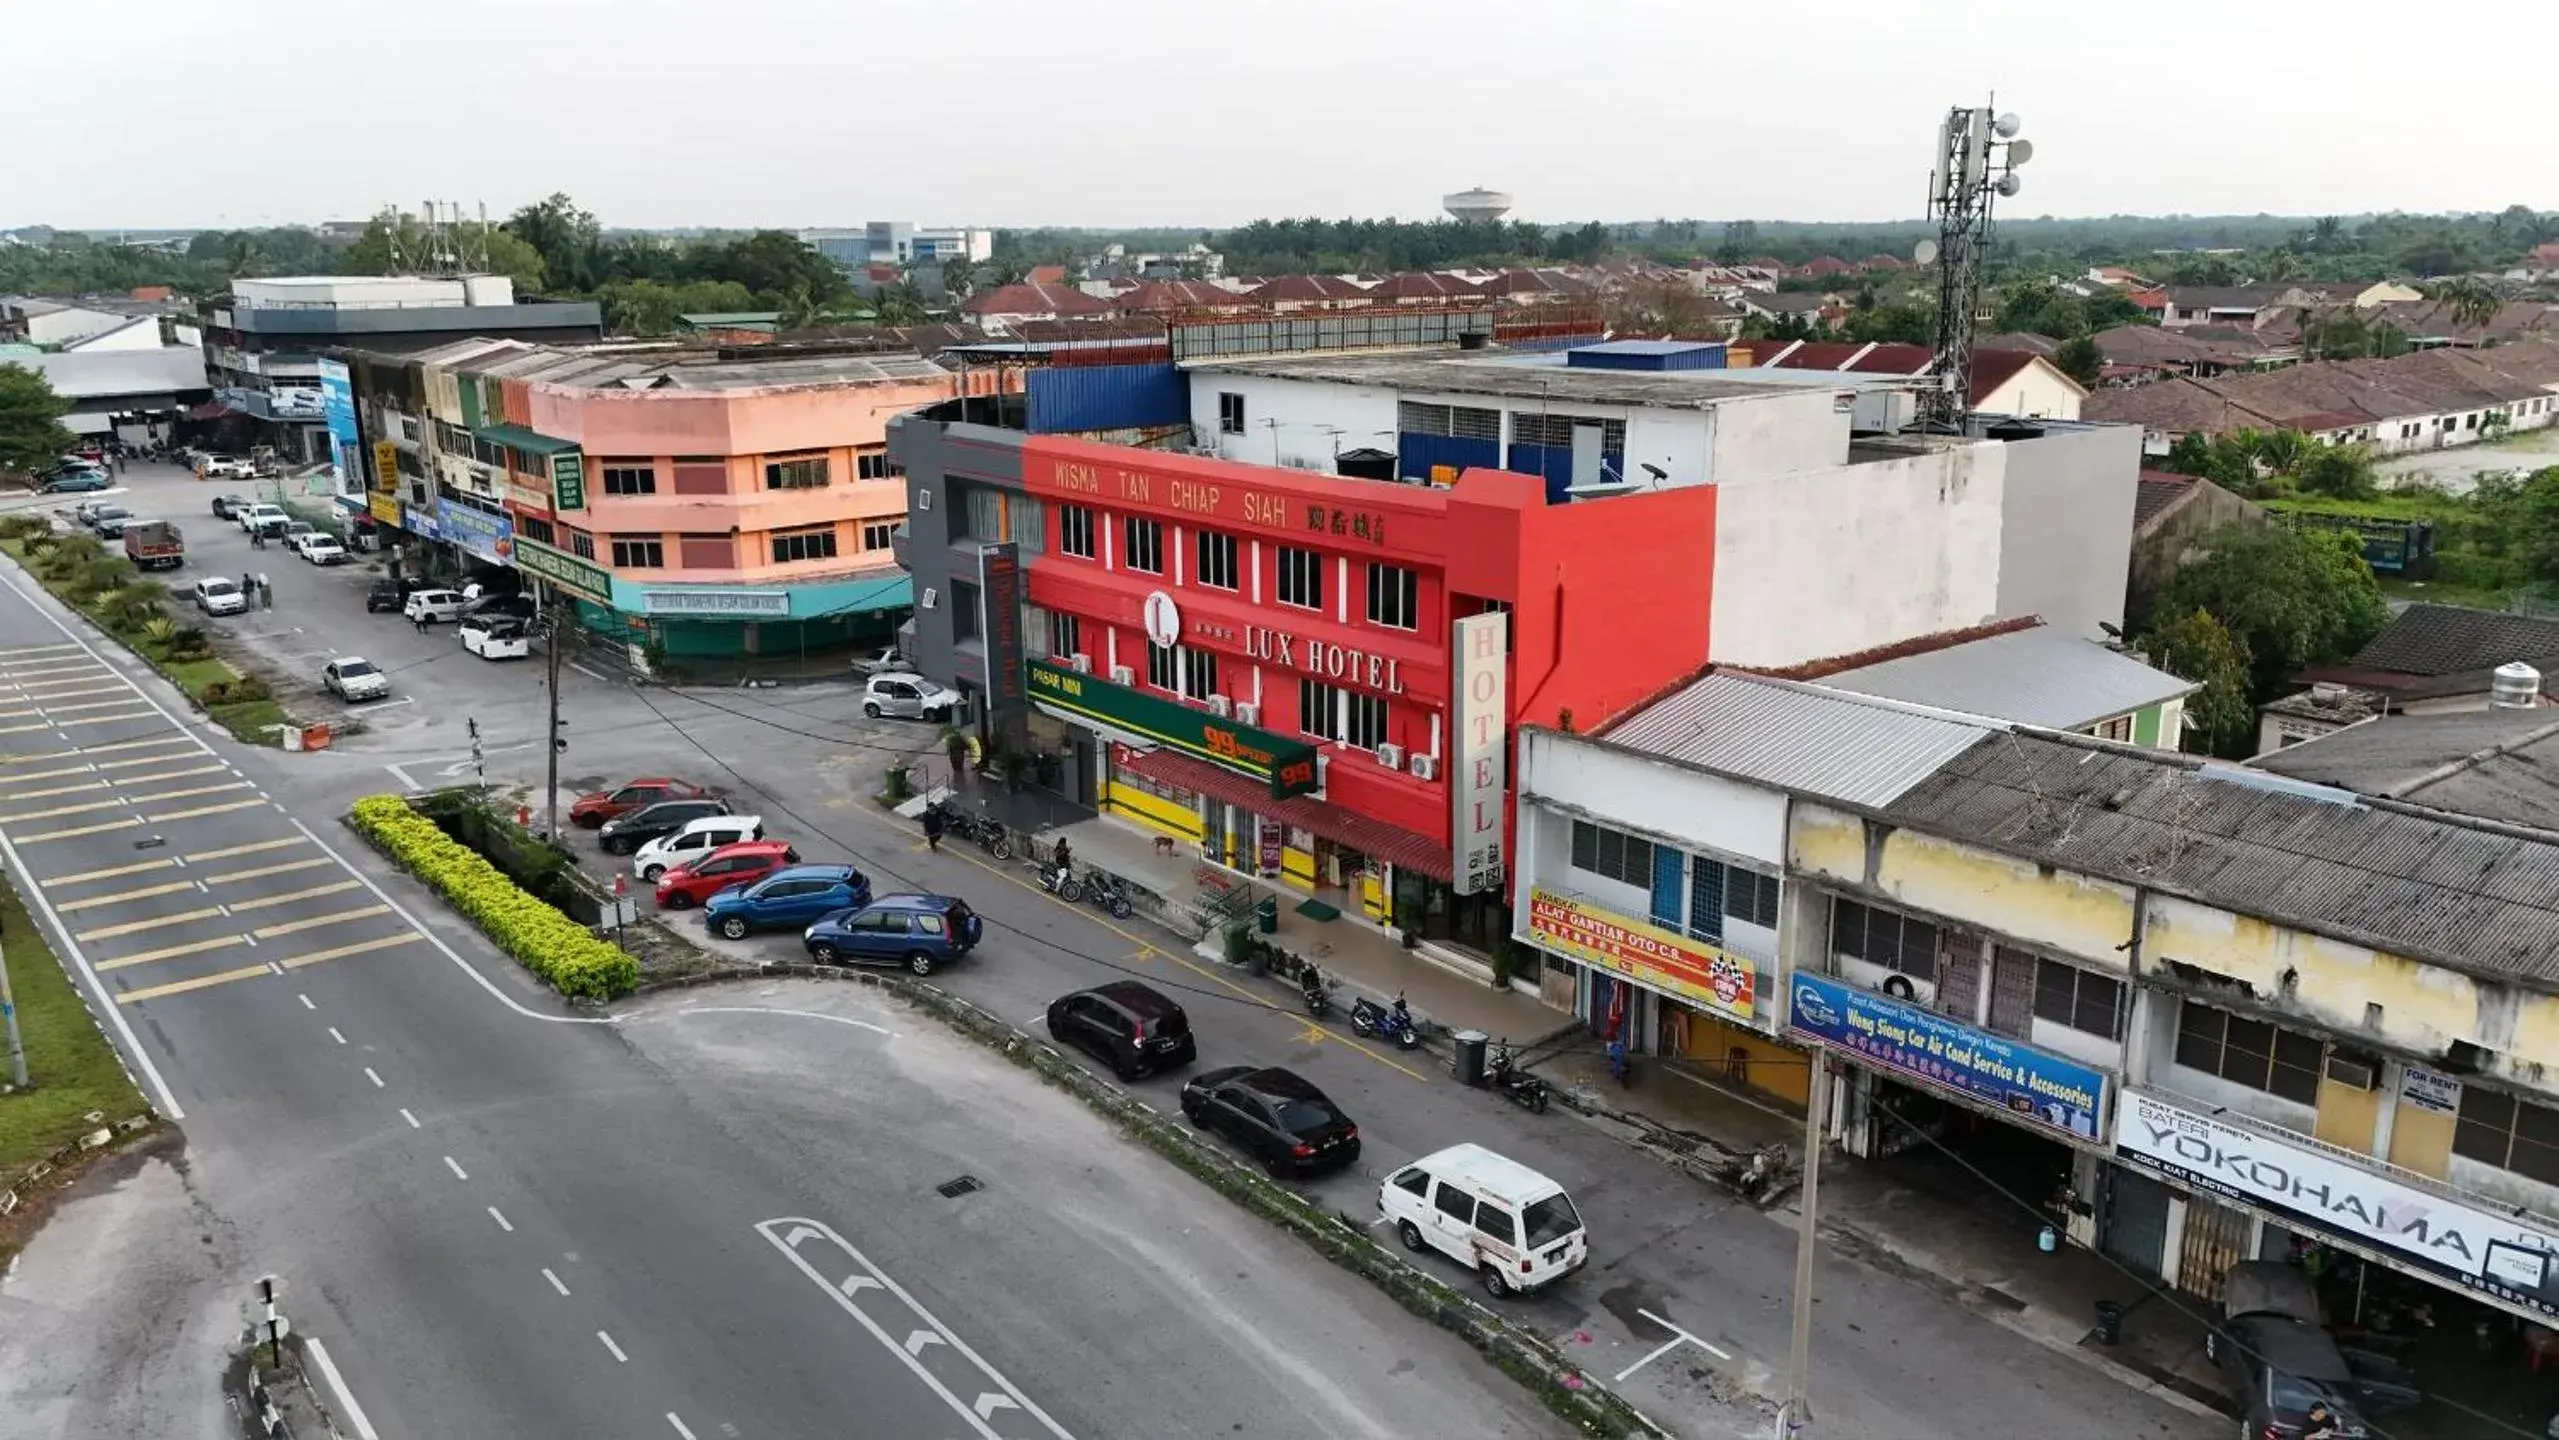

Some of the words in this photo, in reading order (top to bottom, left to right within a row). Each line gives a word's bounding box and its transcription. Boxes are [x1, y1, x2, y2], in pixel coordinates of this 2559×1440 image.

[1119, 471, 1150, 502] TAN
[1171, 480, 1220, 513] CHIAP
[1244, 492, 1288, 528] SIAH
[1244, 625, 1293, 667] LUX
[1307, 639, 1403, 694] HOTEL
[1204, 725, 1237, 757] 99
[1472, 626, 1498, 834] HOTEL
[1281, 761, 1313, 788] 99
[1536, 903, 1566, 920] ALAT
[1569, 913, 1626, 942] GANTIAN
[1628, 934, 1656, 953] OTO
[1908, 1028, 1926, 1049] Car
[1927, 1034, 1944, 1057] Air
[1945, 1041, 1971, 1067] Cond
[1973, 1051, 2013, 1081] Service
[2015, 1066, 2026, 1086] &
[2028, 1071, 2094, 1111] Accessories
[2406, 1068, 2427, 1081] FOR
[2430, 1076, 2458, 1092] RENT
[2138, 1106, 2209, 1140] BATERI
[2140, 1119, 2473, 1262] YOKOHAMA
[2163, 1163, 2188, 1179] KIAT
[2189, 1173, 2240, 1198] ELECTRIC
